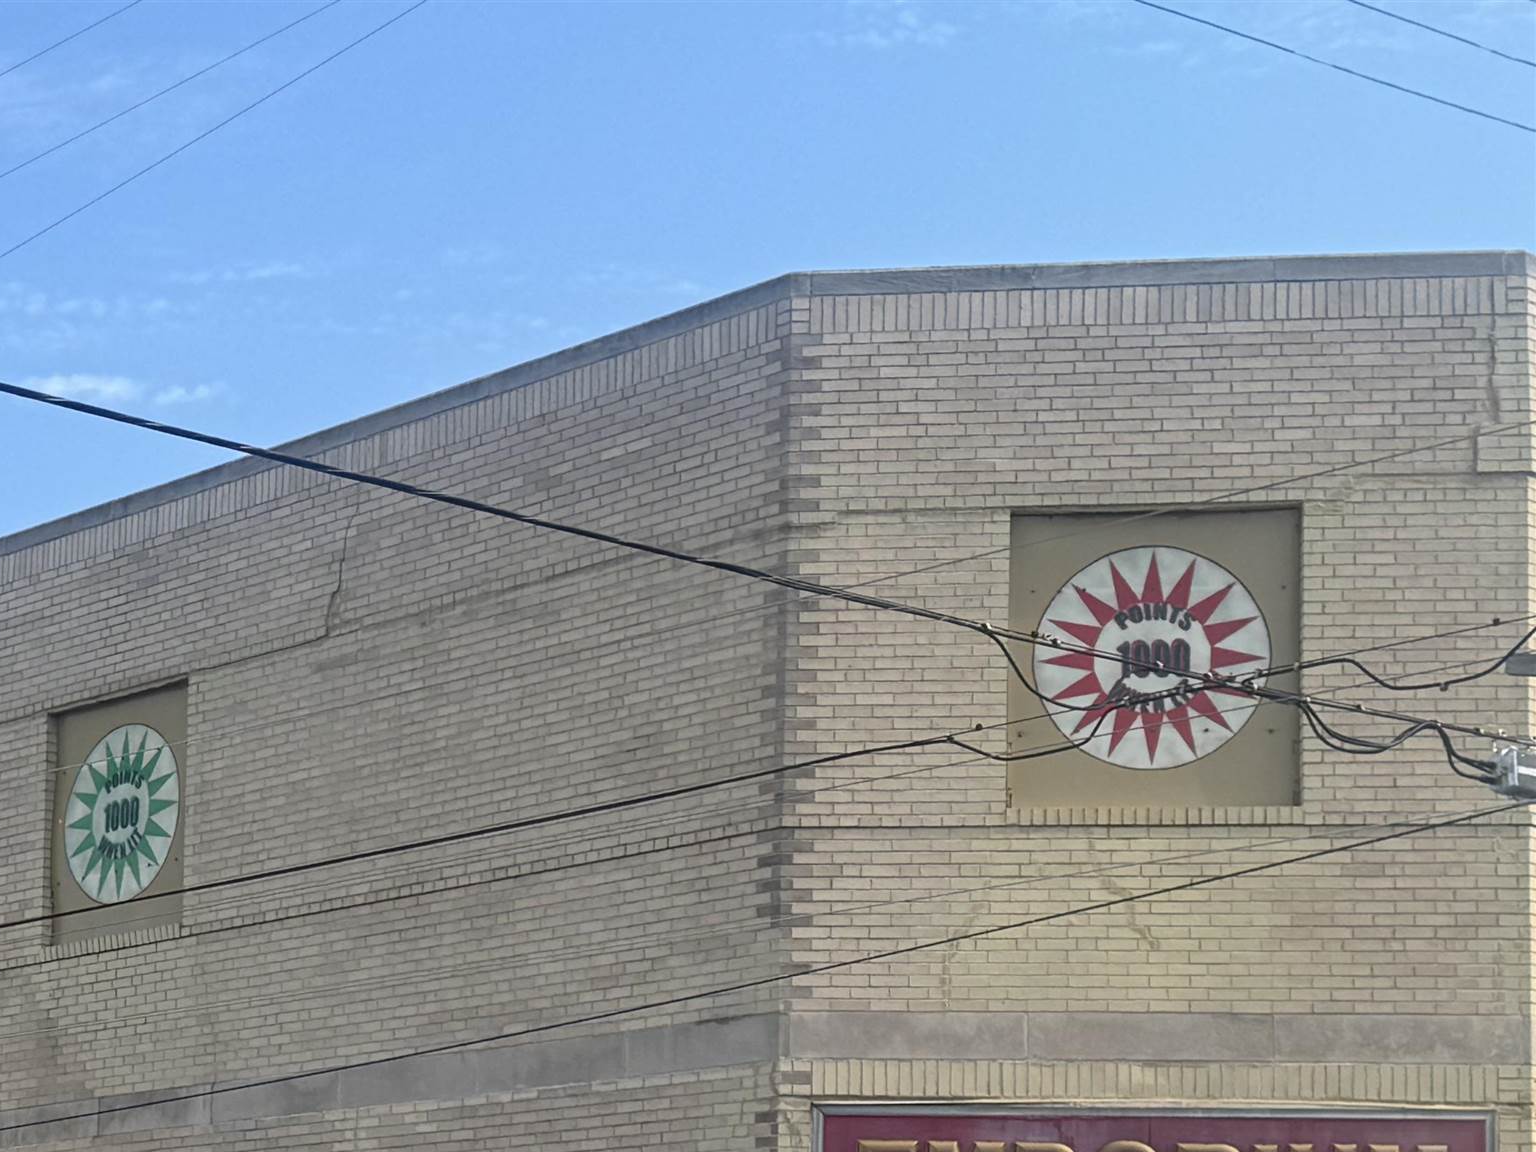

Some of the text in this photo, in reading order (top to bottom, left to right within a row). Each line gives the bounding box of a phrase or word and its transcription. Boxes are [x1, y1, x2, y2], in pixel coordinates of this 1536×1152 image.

[1114, 602, 1195, 632] POINTS
[1116, 638, 1191, 679] 1000
[105, 770, 145, 794] POINTS
[104, 796, 140, 834] 1000
[97, 827, 143, 860] WHEN LIT
